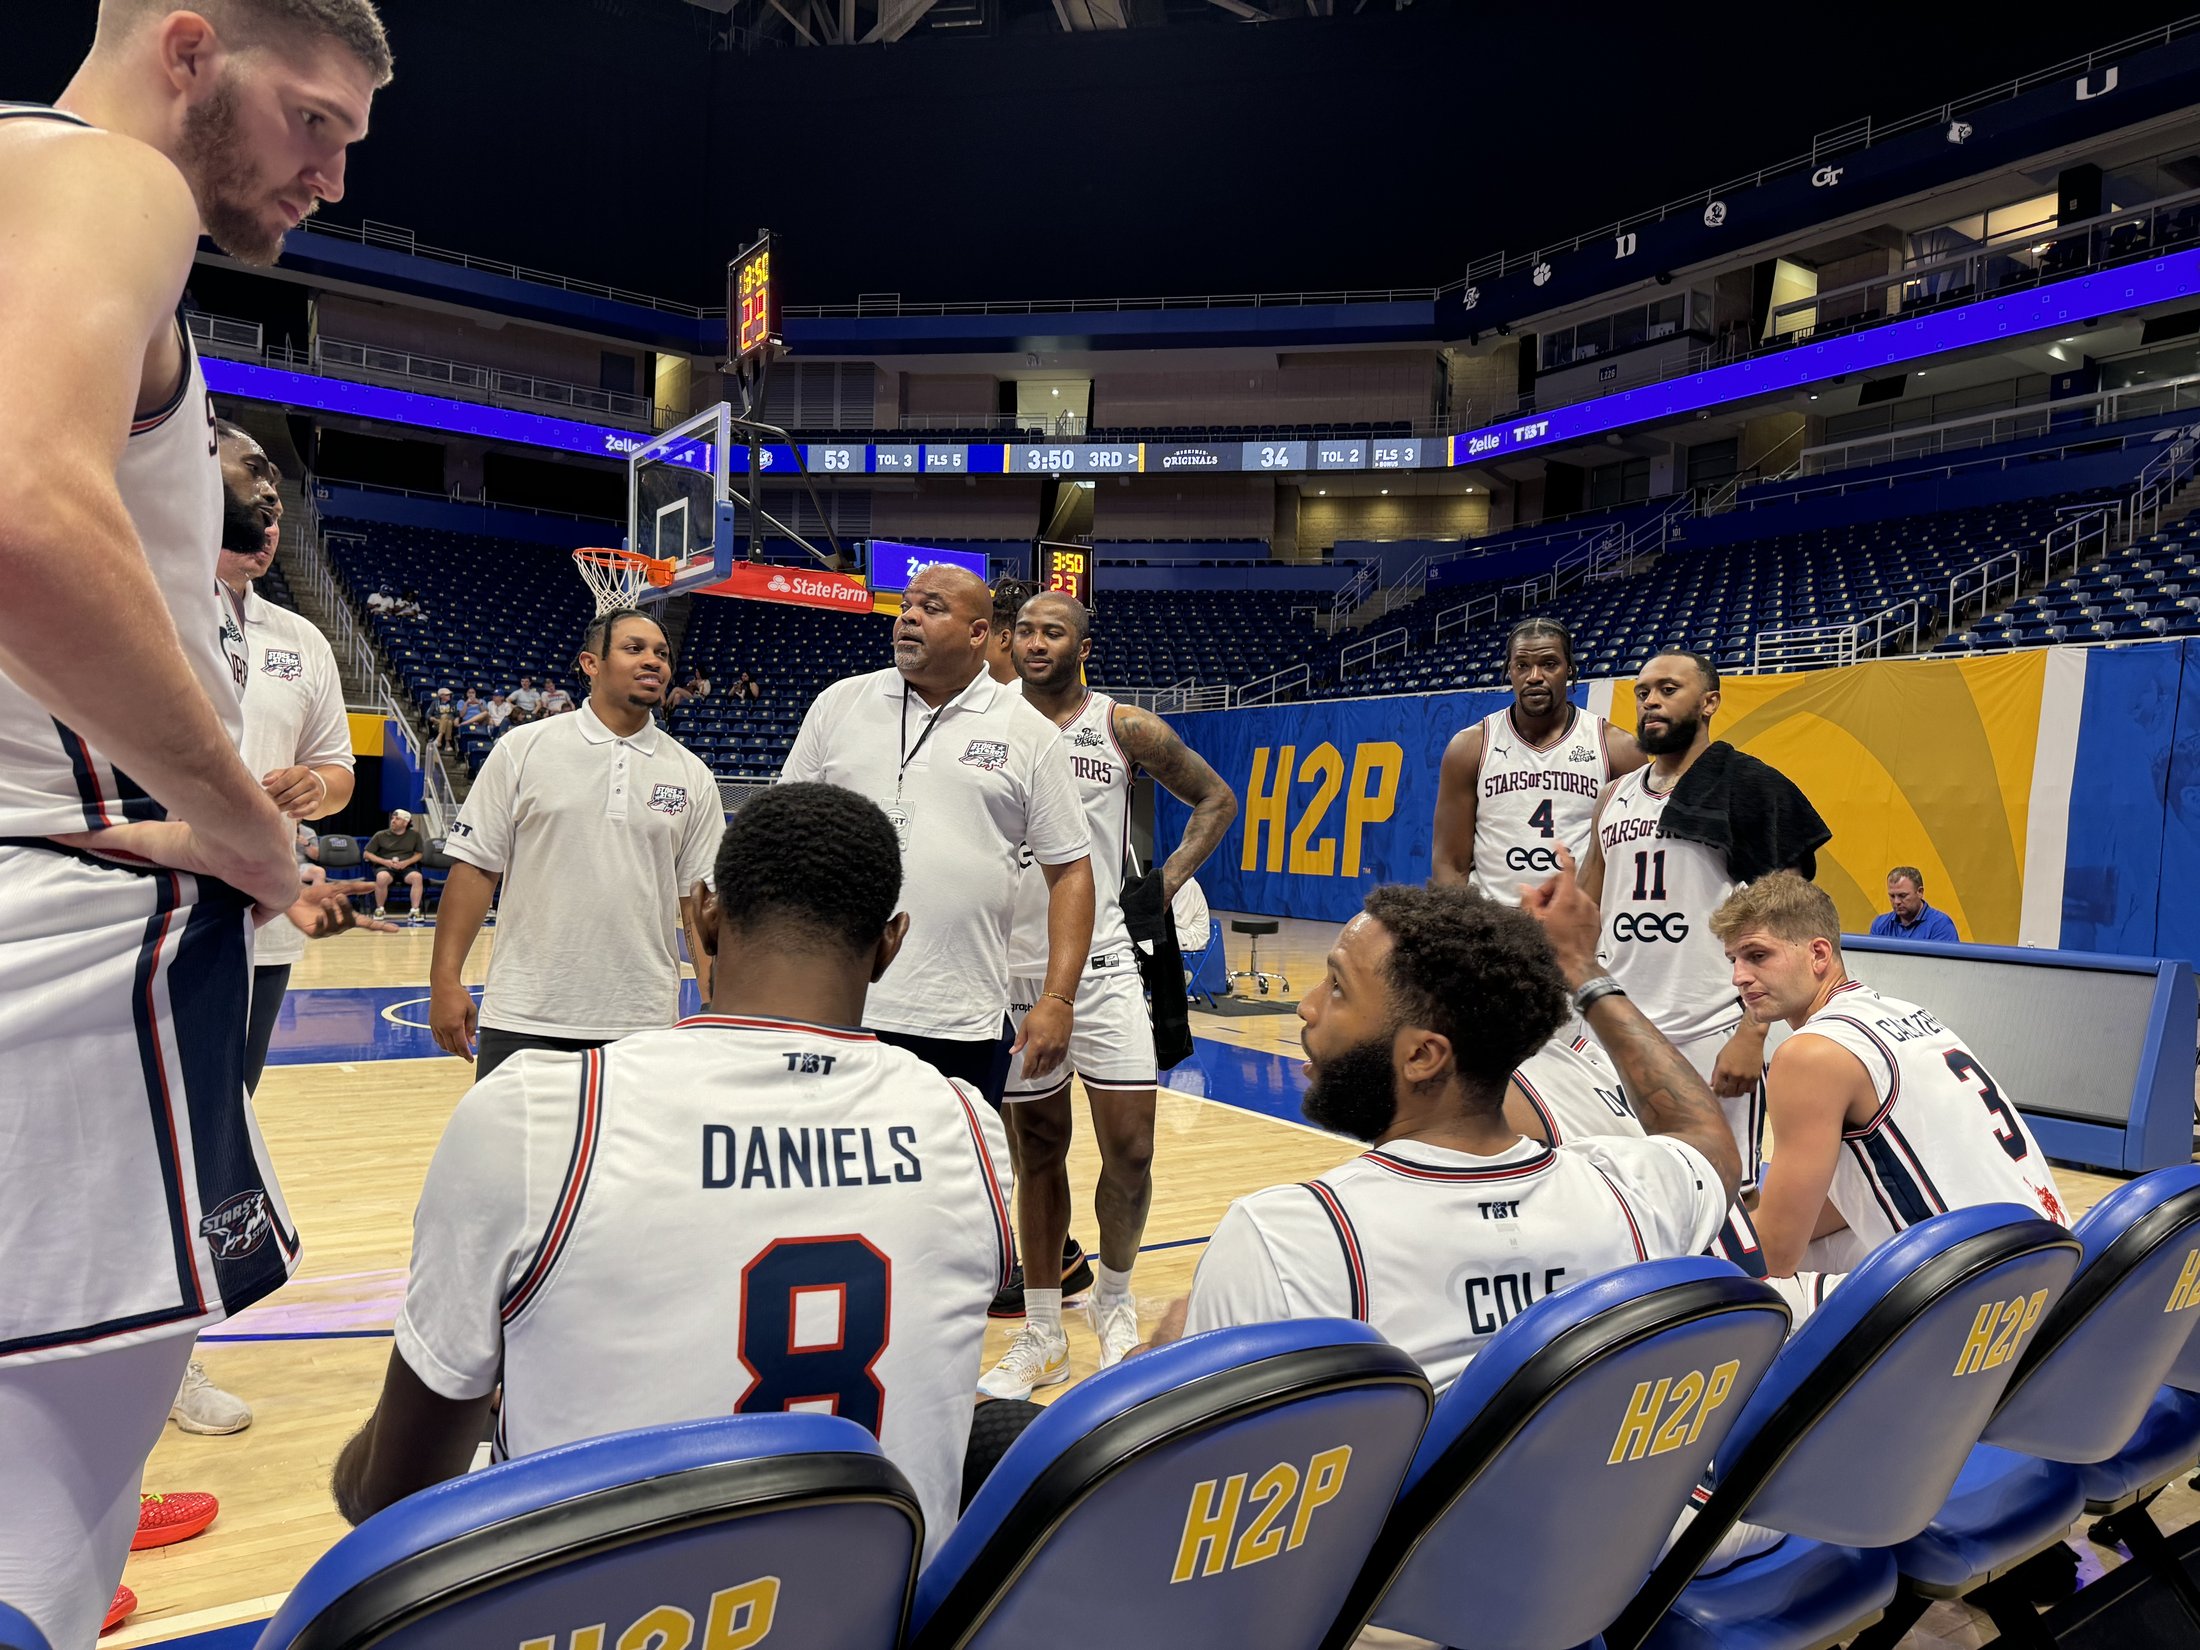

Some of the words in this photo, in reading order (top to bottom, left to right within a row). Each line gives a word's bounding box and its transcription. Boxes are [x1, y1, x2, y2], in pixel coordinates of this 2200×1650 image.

[741, 287, 768, 350] 23
[1468, 435, 1501, 455] Zelle
[1513, 420, 1549, 442] TBT
[824, 450, 850, 470] 53
[878, 454, 899, 465] TOL
[904, 454, 912, 467] 3
[927, 454, 948, 466] FLS
[953, 453, 961, 467] 5
[1028, 449, 1075, 470] 3:50
[1089, 451, 1123, 467] 3RD
[1163, 456, 1218, 468] ORIGINALS
[1261, 447, 1288, 467] 34
[1321, 451, 1344, 463] TOL
[1349, 449, 1359, 463] 2
[1375, 449, 1398, 461] FLS
[1404, 447, 1414, 461] 3
[1053, 551, 1083, 574] 3:50
[1050, 573, 1077, 599] 23
[1485, 771, 1528, 798] STARS
[1542, 770, 1598, 799] STORRS
[1241, 741, 1403, 877] H2P
[1527, 798, 1555, 838] 4
[1632, 850, 1667, 901] 11
[782, 1052, 837, 1076] TBT
[1942, 1047, 2028, 1163] 3
[702, 1123, 923, 1190] DANIELS
[202, 1198, 251, 1234] STARS
[1478, 1200, 1520, 1219] TBT
[733, 1232, 892, 1441] 8
[1952, 1288, 2048, 1377] H2P
[1606, 1358, 1741, 1465] H2P
[1169, 1444, 1352, 1584] H2P
